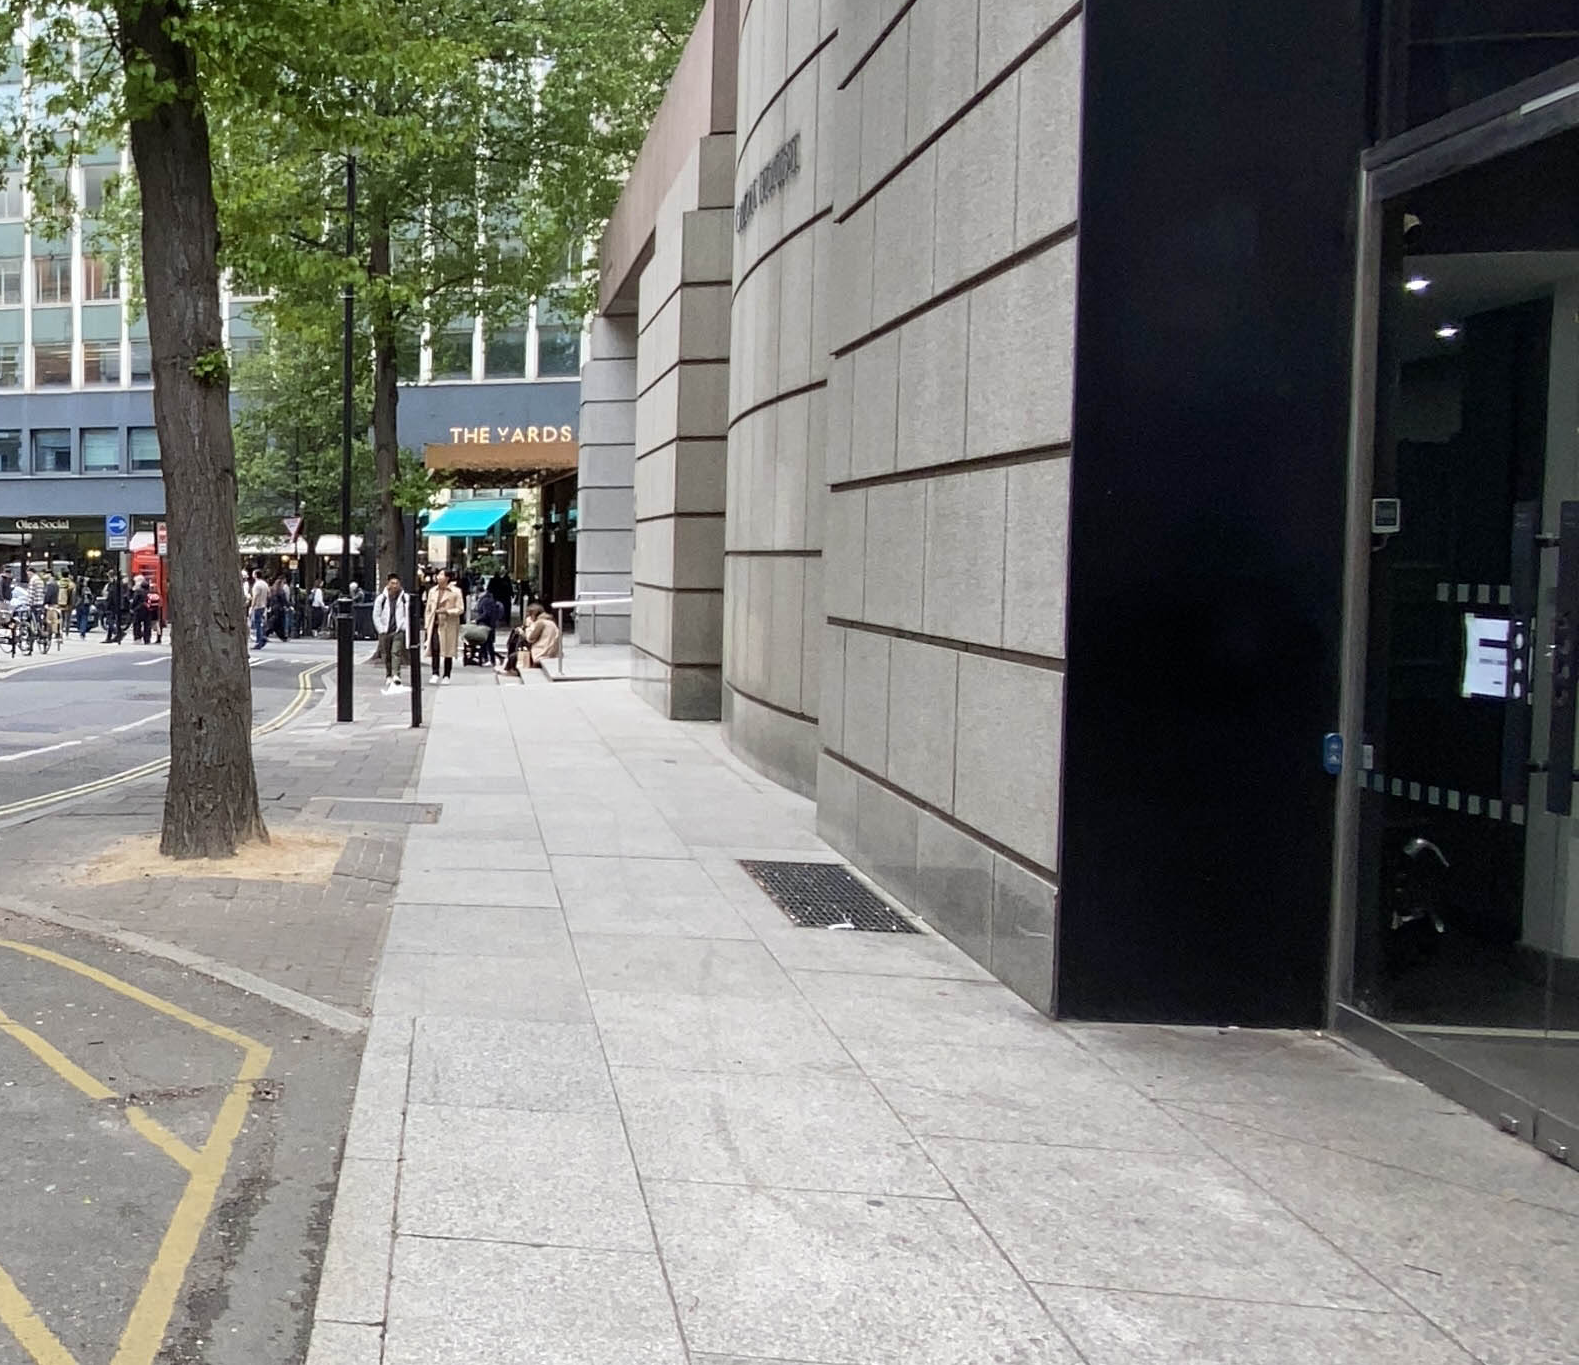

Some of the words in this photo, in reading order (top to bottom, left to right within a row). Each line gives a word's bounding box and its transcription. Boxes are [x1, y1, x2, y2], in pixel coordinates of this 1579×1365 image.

[449, 426, 491, 444] THE
[497, 425, 572, 443] YARDS
[39, 519, 70, 530] Social
